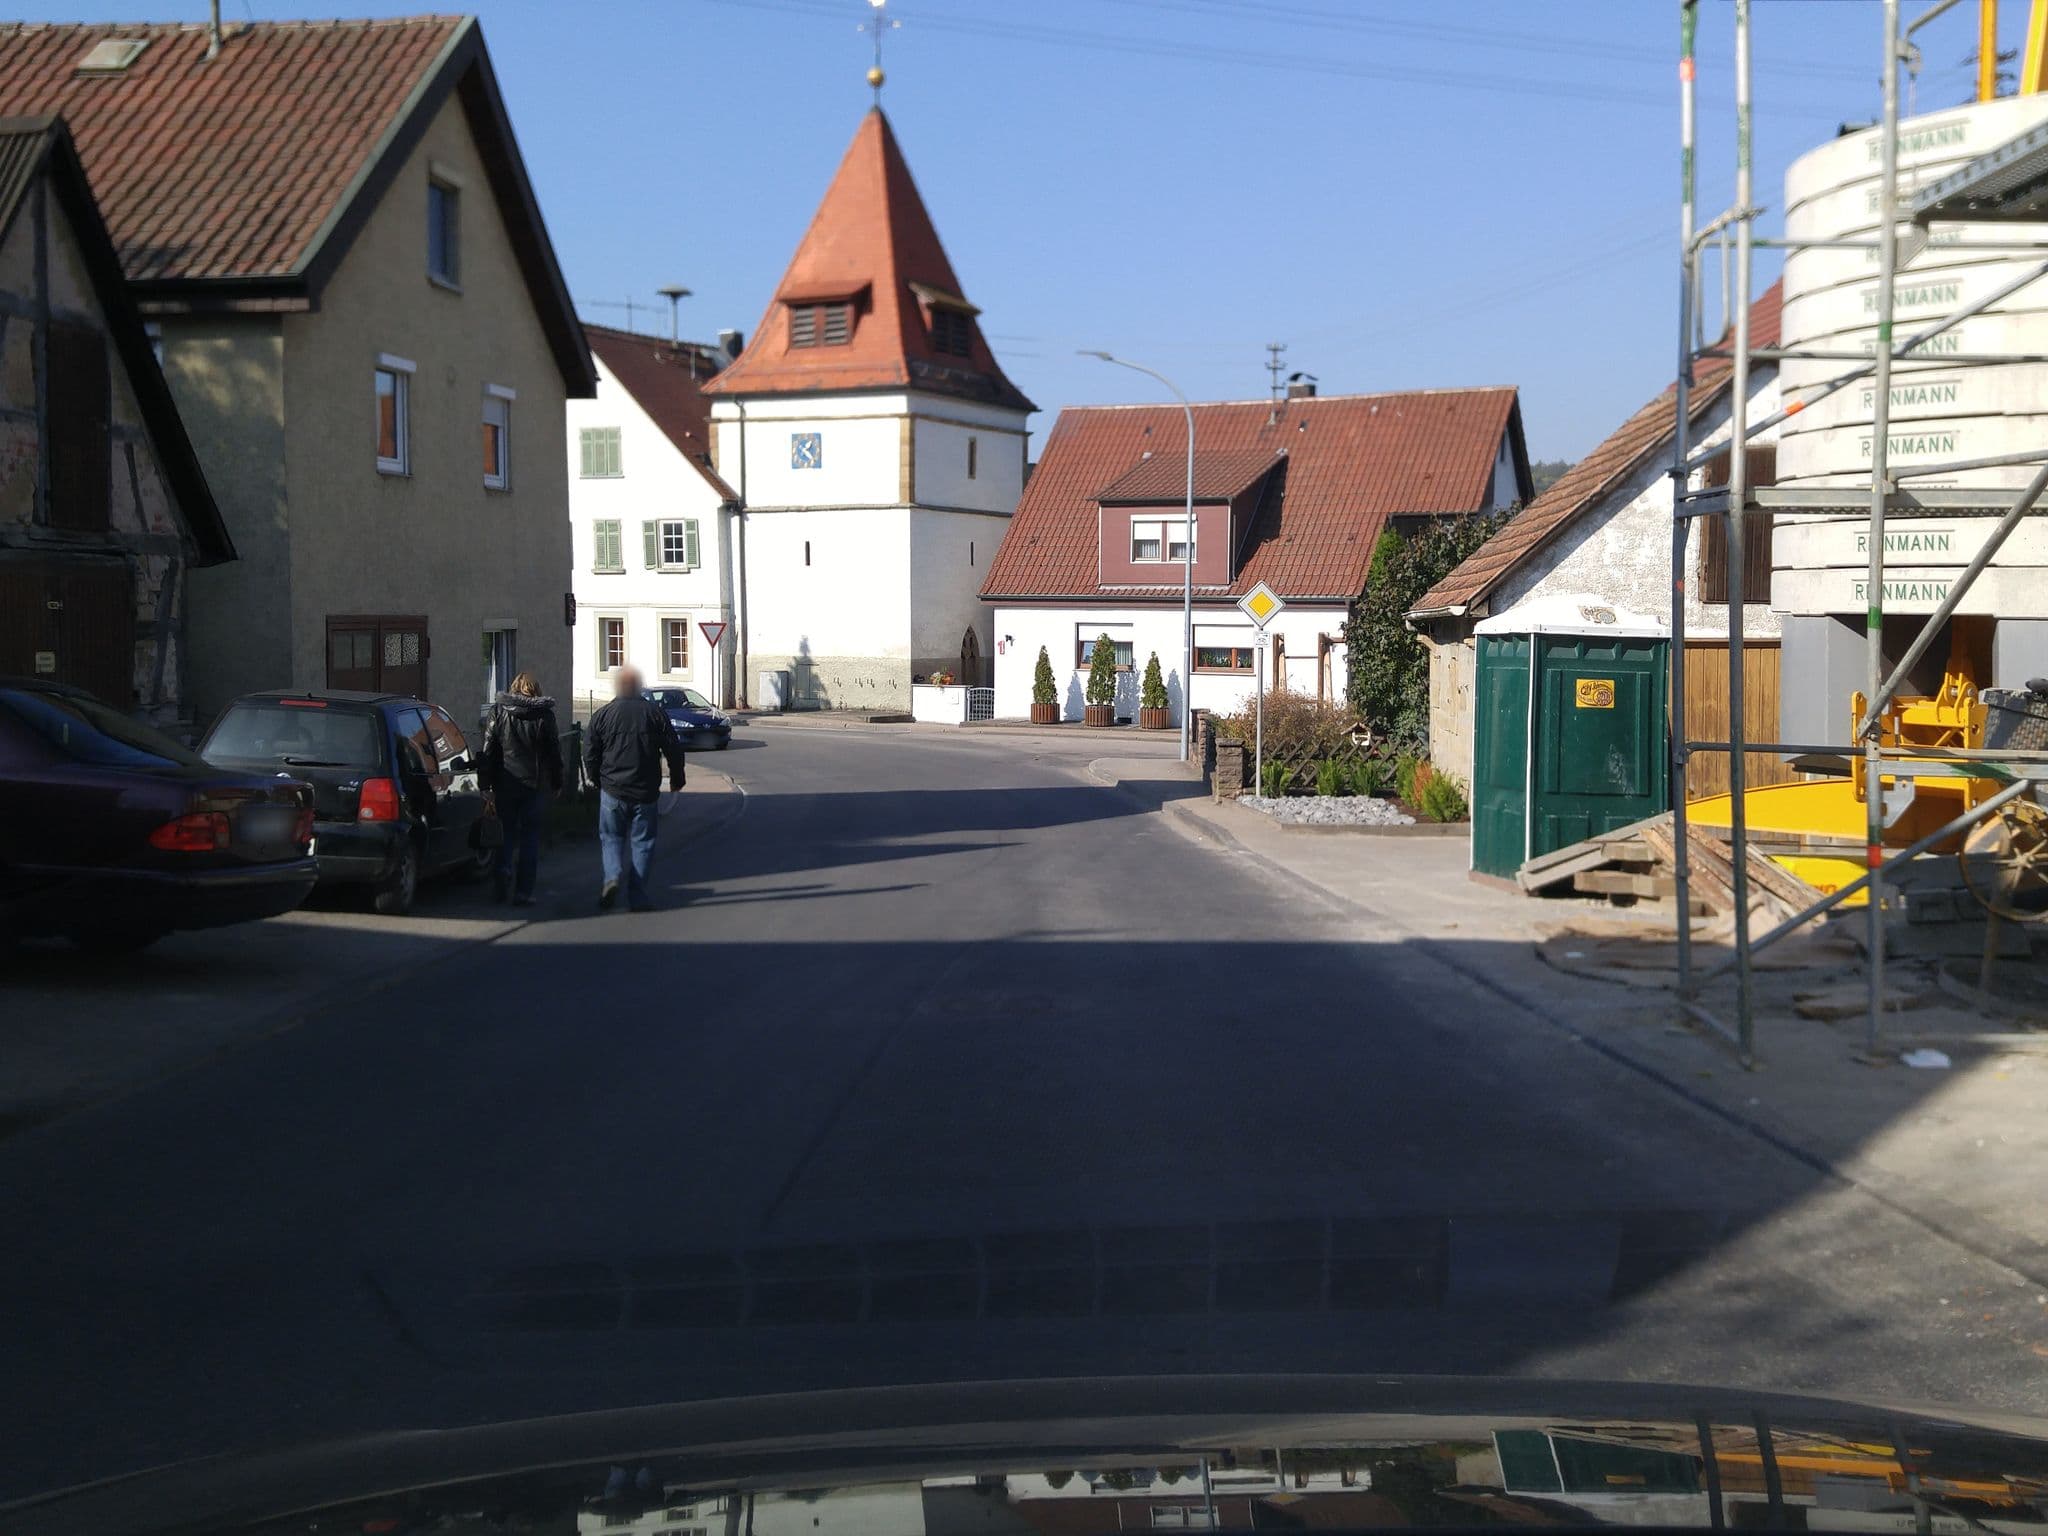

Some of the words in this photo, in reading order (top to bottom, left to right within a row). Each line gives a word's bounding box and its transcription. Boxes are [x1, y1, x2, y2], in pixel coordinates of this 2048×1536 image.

[1863, 284, 1960, 313] RNMANN
[1863, 384, 1957, 409] RNMANN
[1861, 435, 1955, 457] RNMANN
[1857, 534, 1950, 553] RNMANN
[1855, 583, 1948, 601] RNMANN
